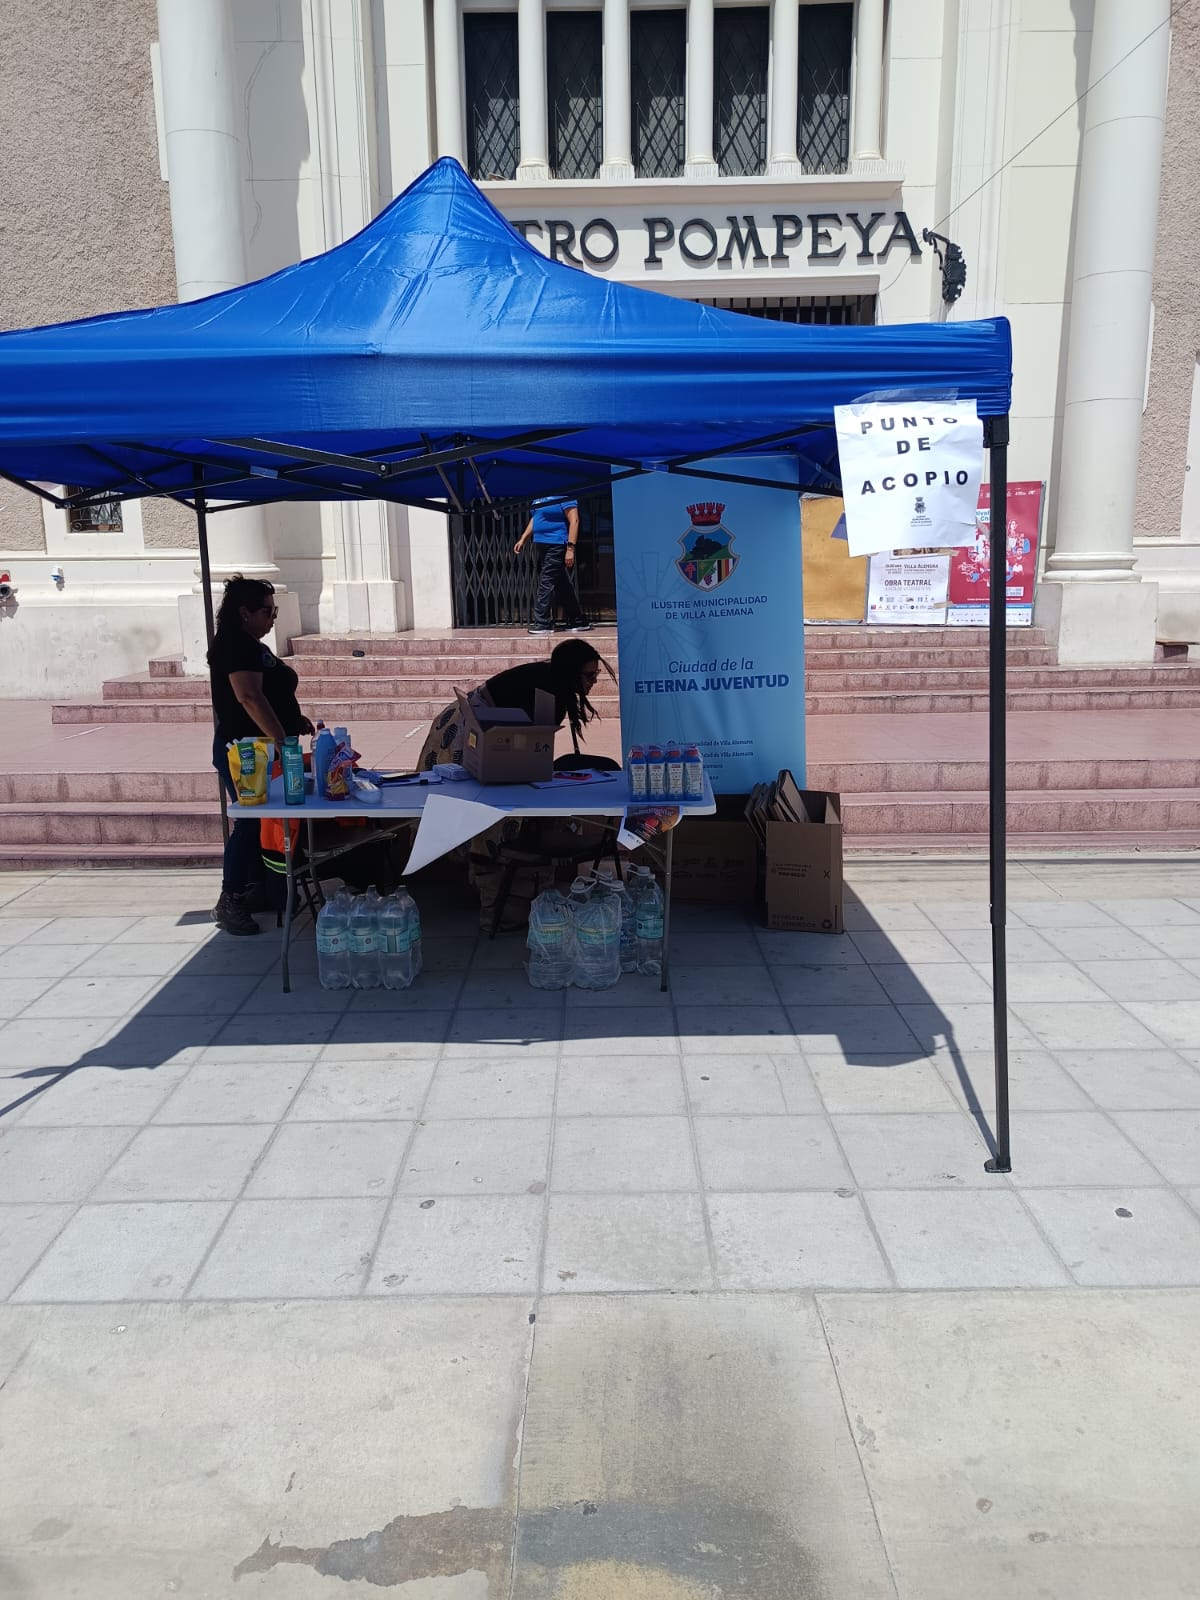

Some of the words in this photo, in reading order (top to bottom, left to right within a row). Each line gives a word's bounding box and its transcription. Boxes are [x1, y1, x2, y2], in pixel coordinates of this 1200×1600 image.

[643, 211, 923, 263] POMPEYA
[860, 416, 959, 435] PUNTO
[896, 437, 931, 455] DE
[860, 470, 969, 495] ACOPIO
[884, 579, 902, 587] OBRA
[651, 599, 690, 609] ILUSTRE
[693, 595, 767, 608] MUNICIPALIDAD
[665, 611, 678, 620] DE
[681, 610, 706, 619] VILLA
[708, 607, 754, 618] ALEMANA
[668, 659, 717, 673] Ciudad
[721, 658, 737, 671] de
[741, 657, 753, 670] la
[634, 678, 698, 693] ETERNA
[701, 674, 789, 691] JUVENTUD
